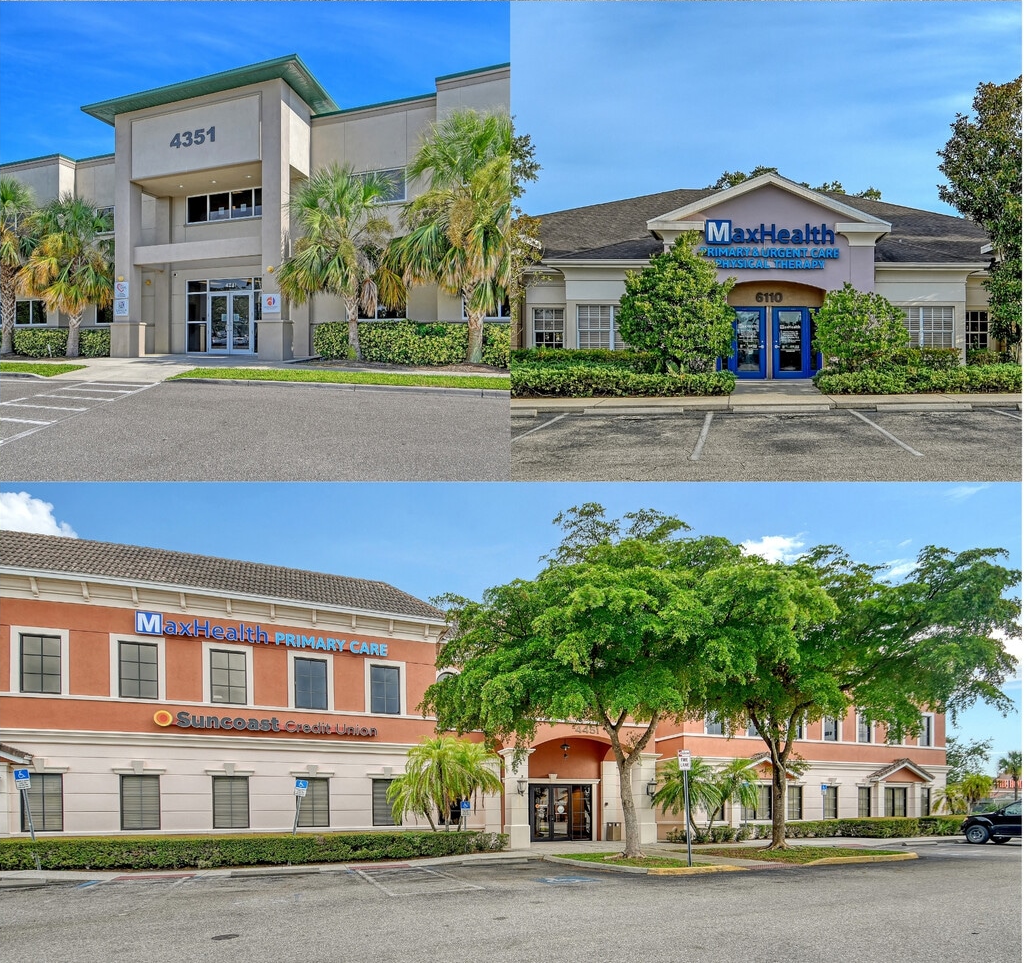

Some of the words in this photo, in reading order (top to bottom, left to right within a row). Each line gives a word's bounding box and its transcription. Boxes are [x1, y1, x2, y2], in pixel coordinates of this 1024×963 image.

[170, 127, 216, 149] 4351
[706, 220, 835, 245] MaxHealth
[700, 247, 750, 257] PRIMARY
[753, 247, 759, 257] &
[762, 247, 808, 258] URGENT
[810, 248, 840, 259] CARE
[716, 258, 771, 269] PHYSICAL
[774, 259, 825, 269] THERAPY
[755, 292, 783, 303] 6110
[135, 611, 269, 644] MaxHealth
[275, 632, 347, 653] PRIMARY
[349, 640, 388, 657] CARE
[176, 711, 280, 732] Suncoast
[284, 720, 332, 735] Credit
[336, 724, 378, 737] Union
[575, 726, 599, 734] 4451
